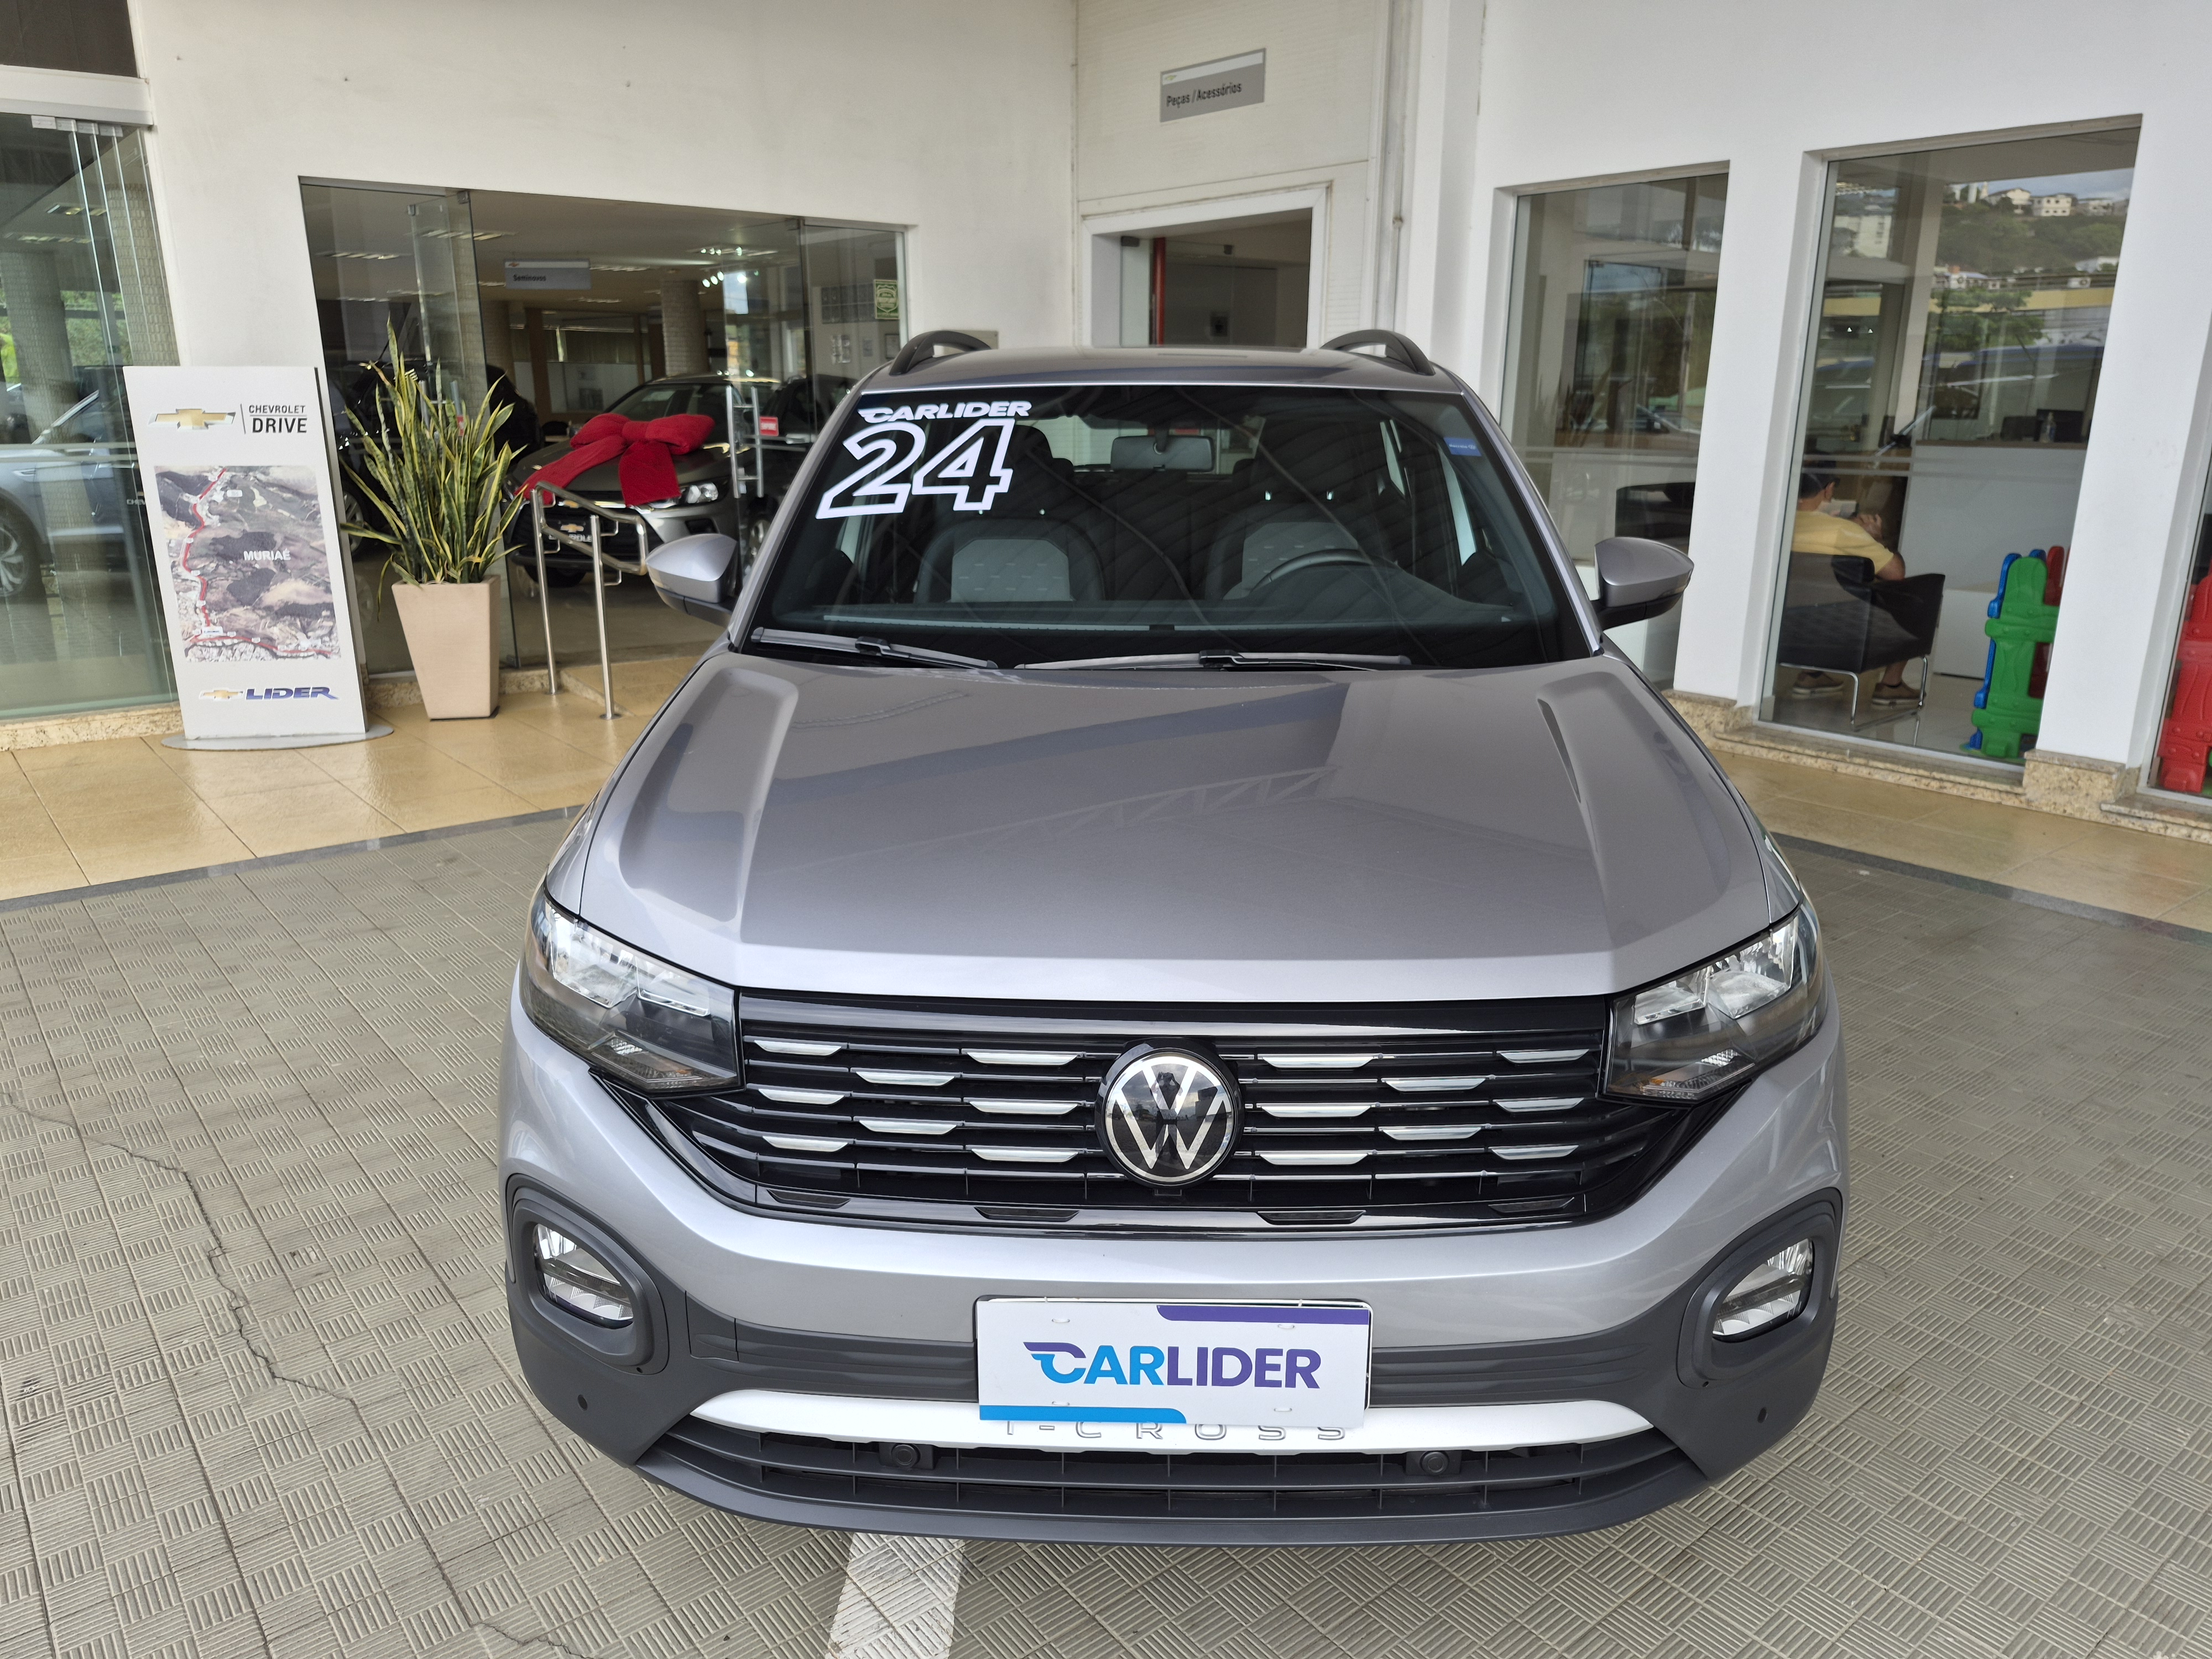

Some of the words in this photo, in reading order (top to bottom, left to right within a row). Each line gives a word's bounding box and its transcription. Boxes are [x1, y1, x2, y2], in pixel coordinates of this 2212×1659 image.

[1166, 93, 1191, 108] Peças
[248, 404, 306, 414] CHEVROLET
[858, 400, 1032, 424] CARLIDER
[252, 418, 307, 434] DRIVE
[815, 418, 1015, 519] 24
[243, 549, 291, 561] MURIAÉ
[246, 686, 341, 701] LIDER
[1107, 1054, 1233, 1179] VW
[1022, 1342, 1322, 1389] CARLIDER
